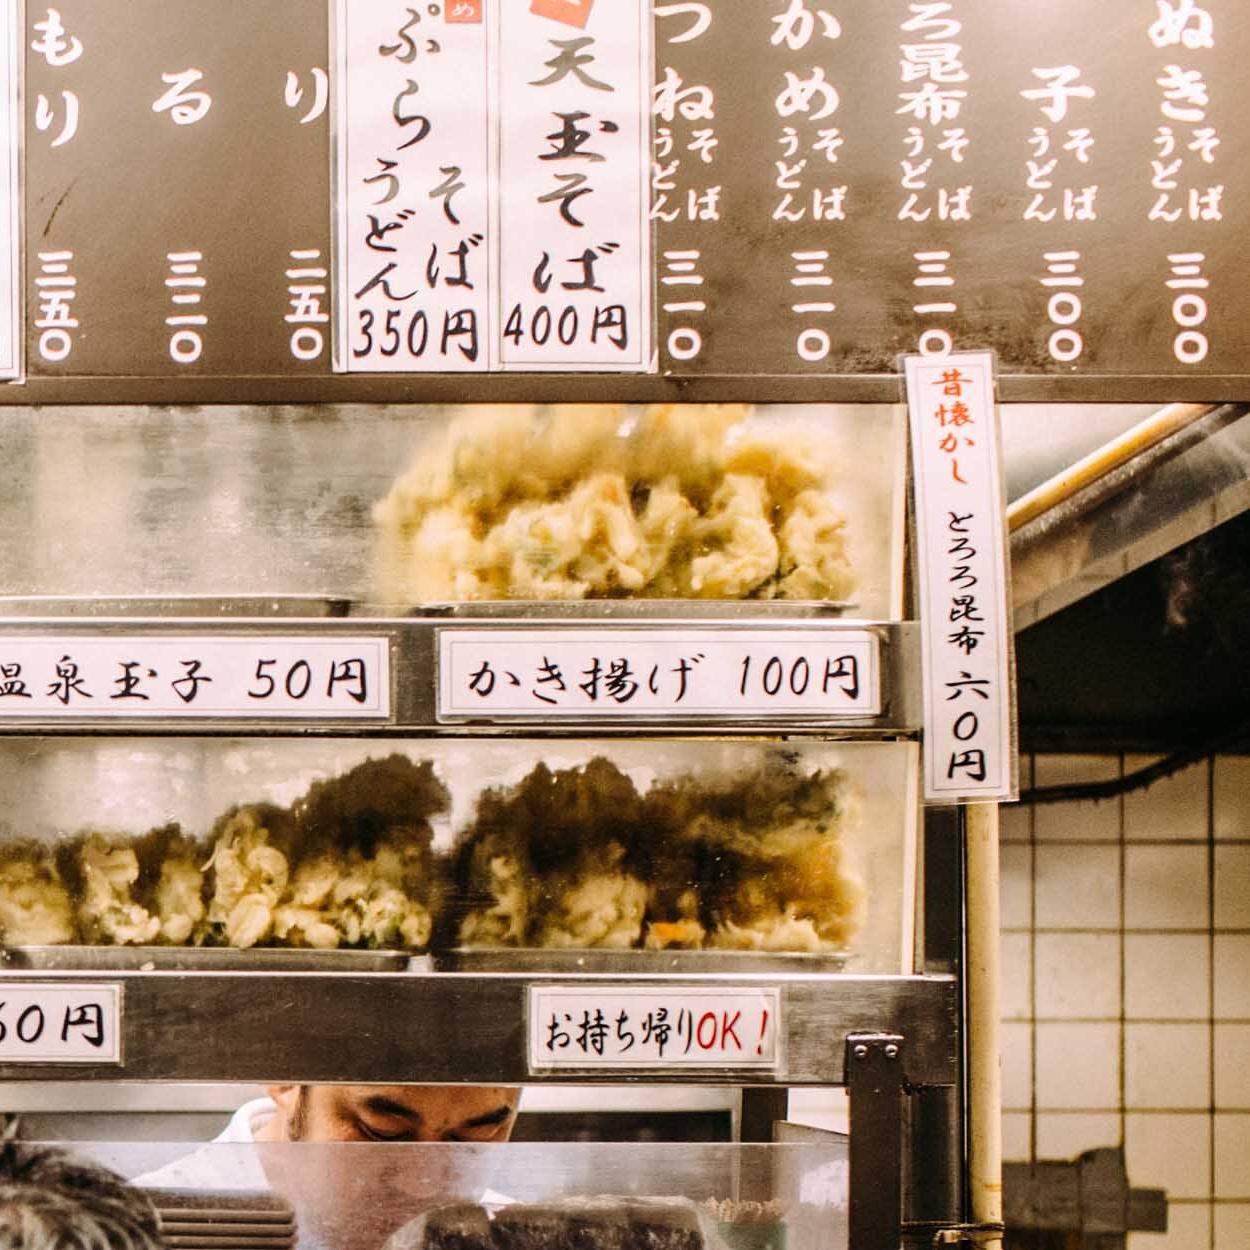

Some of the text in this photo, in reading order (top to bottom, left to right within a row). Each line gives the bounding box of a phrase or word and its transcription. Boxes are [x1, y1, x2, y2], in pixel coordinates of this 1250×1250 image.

[151, 68, 212, 125] る
[284, 67, 329, 124] り
[378, 3, 441, 151] ぷら
[653, 2, 715, 122] つね
[770, 0, 842, 121] かめ
[895, 1, 970, 126] ろ昆布
[1020, 63, 1096, 123] 子
[1147, 0, 1215, 122] ぬき
[30, 8, 84, 362] もり 三五〇
[528, 37, 621, 295] 天玉そば
[686, 128, 722, 221] そば
[772, 126, 807, 222] うどん
[812, 127, 848, 221] そば
[897, 126, 933, 222] うどん
[936, 127, 973, 221] そば
[1023, 126, 1058, 222] うどん
[1062, 127, 1098, 221] そば
[1148, 126, 1183, 222] うどん
[1187, 127, 1224, 221] そば
[354, 157, 418, 302] うどん
[425, 165, 484, 291] そば
[353, 308, 479, 363] 350円
[502, 303, 628, 351] 400円
[932, 368, 975, 484] 昔懐かし
[947, 511, 986, 656] とろろ昆布
[247, 658, 367, 704] 50円
[468, 653, 859, 705] かき揚げ 100円
